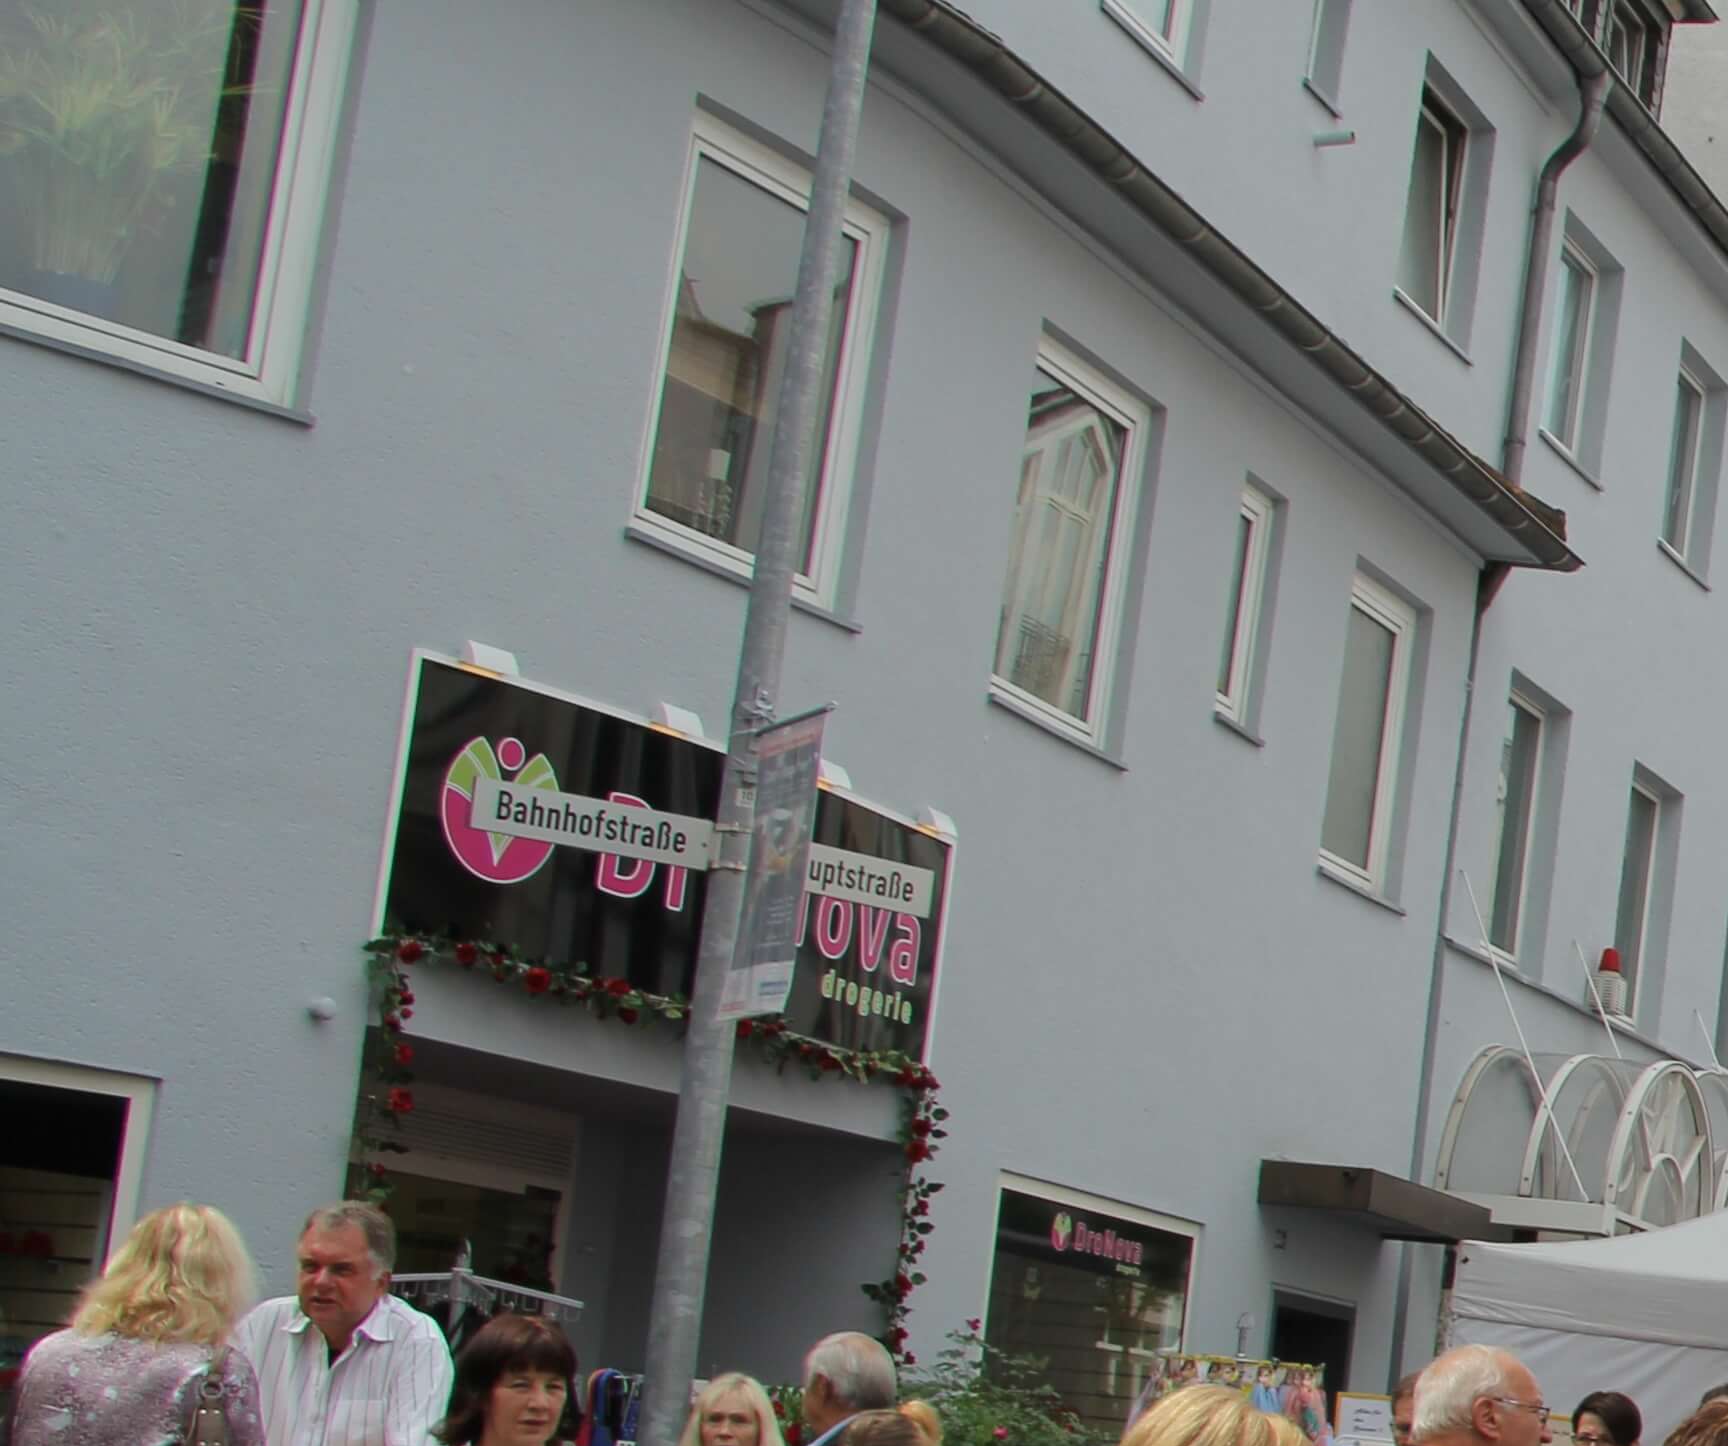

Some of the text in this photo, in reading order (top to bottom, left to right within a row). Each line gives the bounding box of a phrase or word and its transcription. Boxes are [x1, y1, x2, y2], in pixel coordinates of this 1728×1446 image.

[496, 790, 687, 853] Bahnhofstraße
[809, 859, 914, 902] uptstraße
[821, 969, 914, 1024] drogerie
